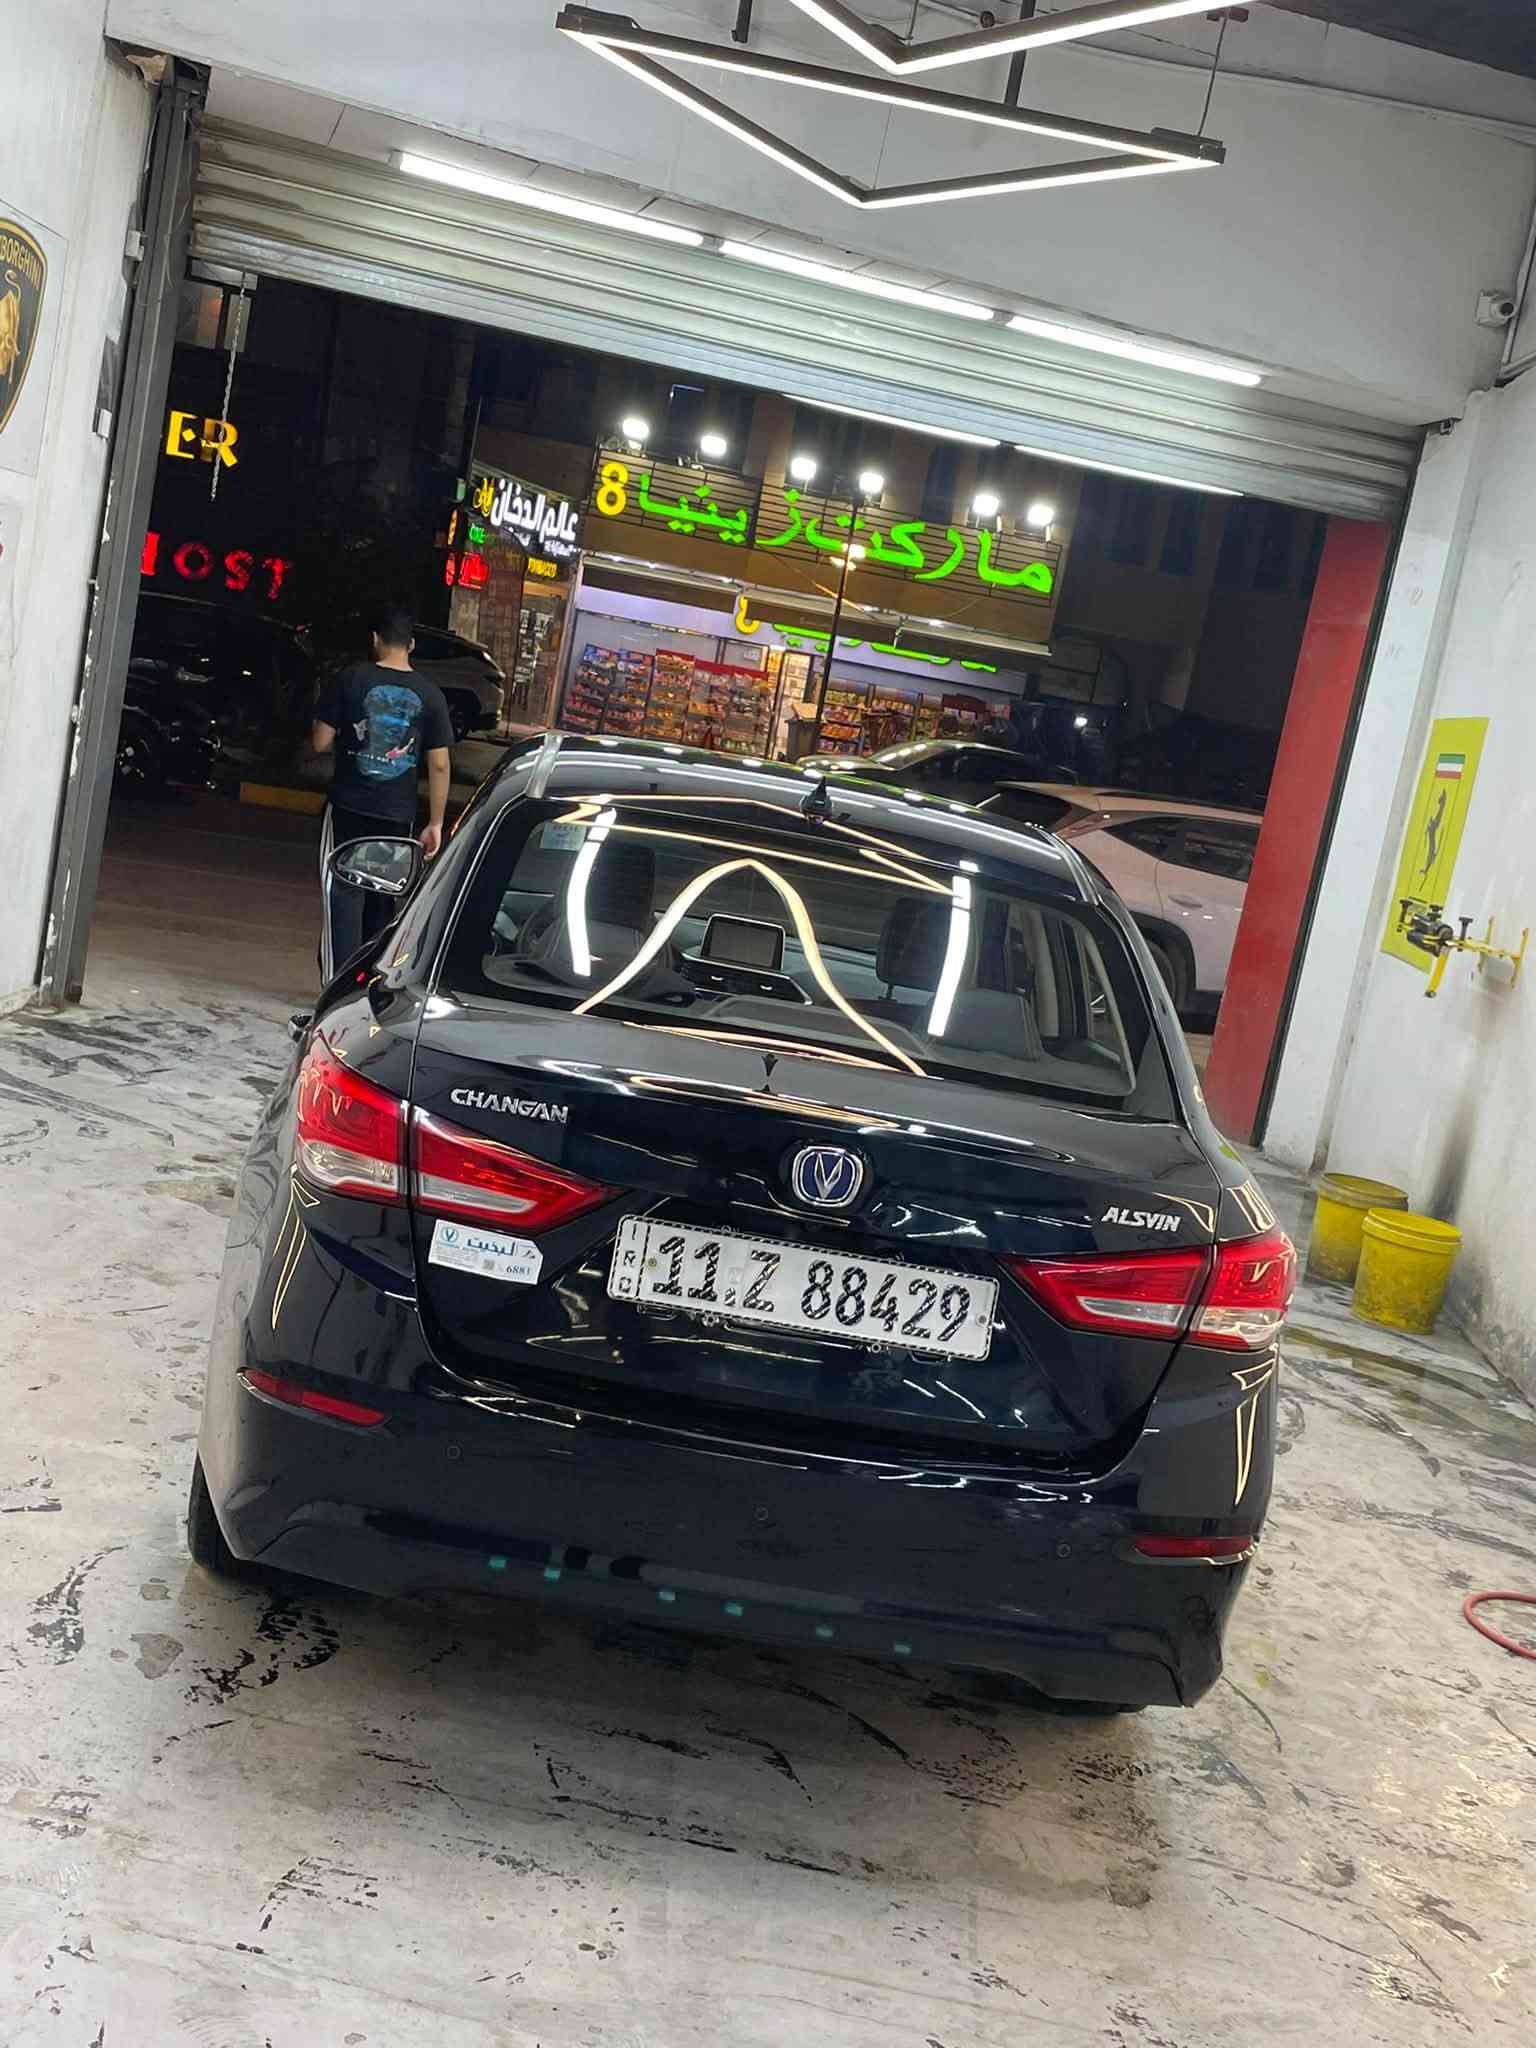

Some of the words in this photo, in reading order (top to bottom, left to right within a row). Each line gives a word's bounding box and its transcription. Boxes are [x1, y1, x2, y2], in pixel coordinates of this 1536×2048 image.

[490, 478, 546, 532] الدخان
[597, 461, 629, 516] 8
[540, 500, 579, 543] عالم
[804, 513, 1053, 593] ماركت
[450, 1088, 569, 1123] CHANGAN
[1101, 1206, 1181, 1232] ALSVIN
[801, 1259, 970, 1342] 88429
